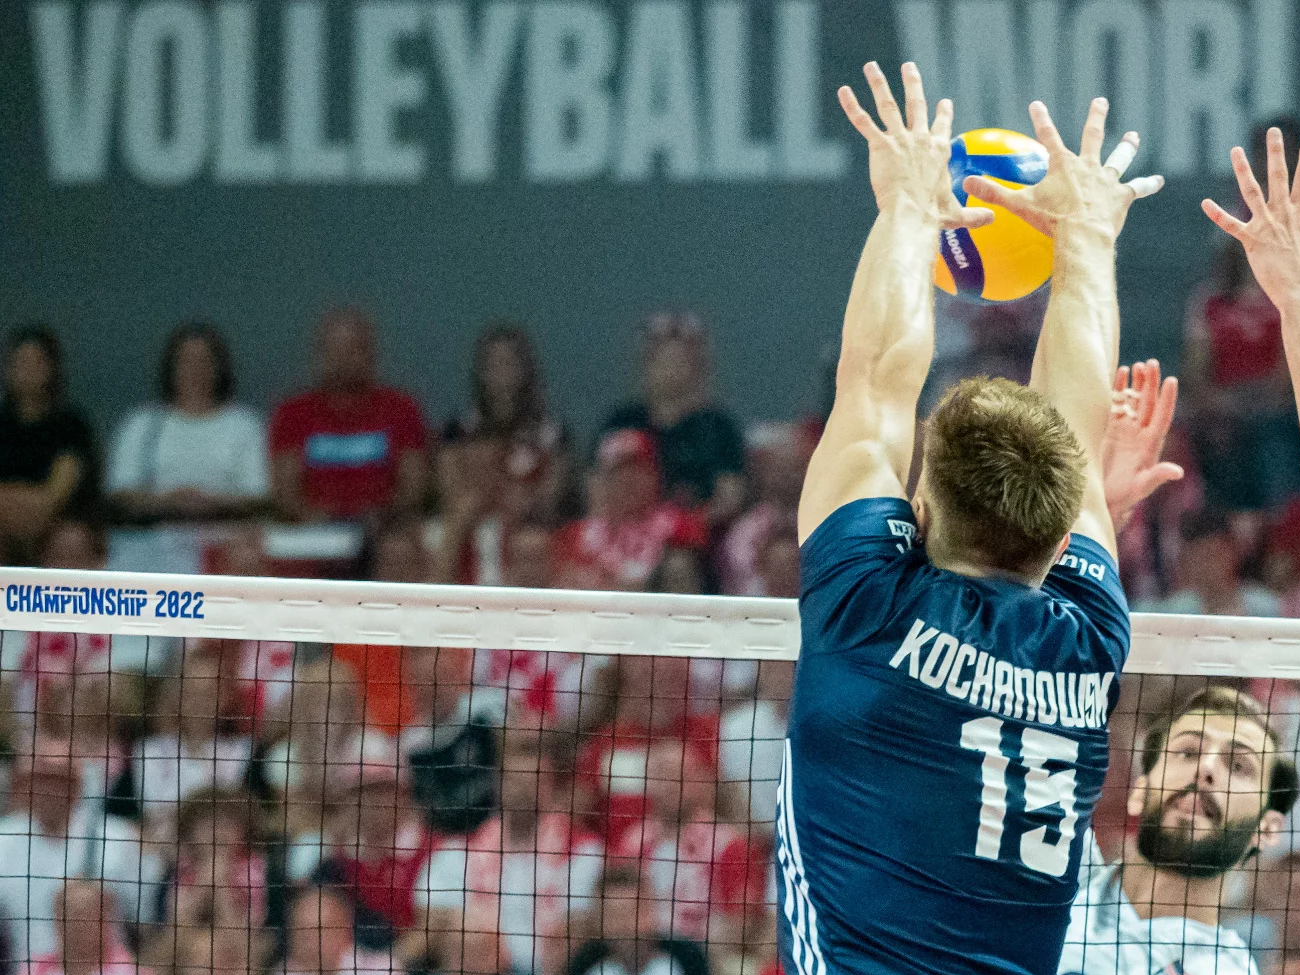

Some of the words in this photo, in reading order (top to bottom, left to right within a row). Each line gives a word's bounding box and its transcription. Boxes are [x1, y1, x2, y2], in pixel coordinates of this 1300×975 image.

[30, 0, 847, 186] VOLLEYBALL
[6, 584, 148, 617] CHAMPIONSHIP
[154, 589, 205, 619] 2022
[1060, 553, 1106, 582] plu
[959, 716, 1079, 878] 15
